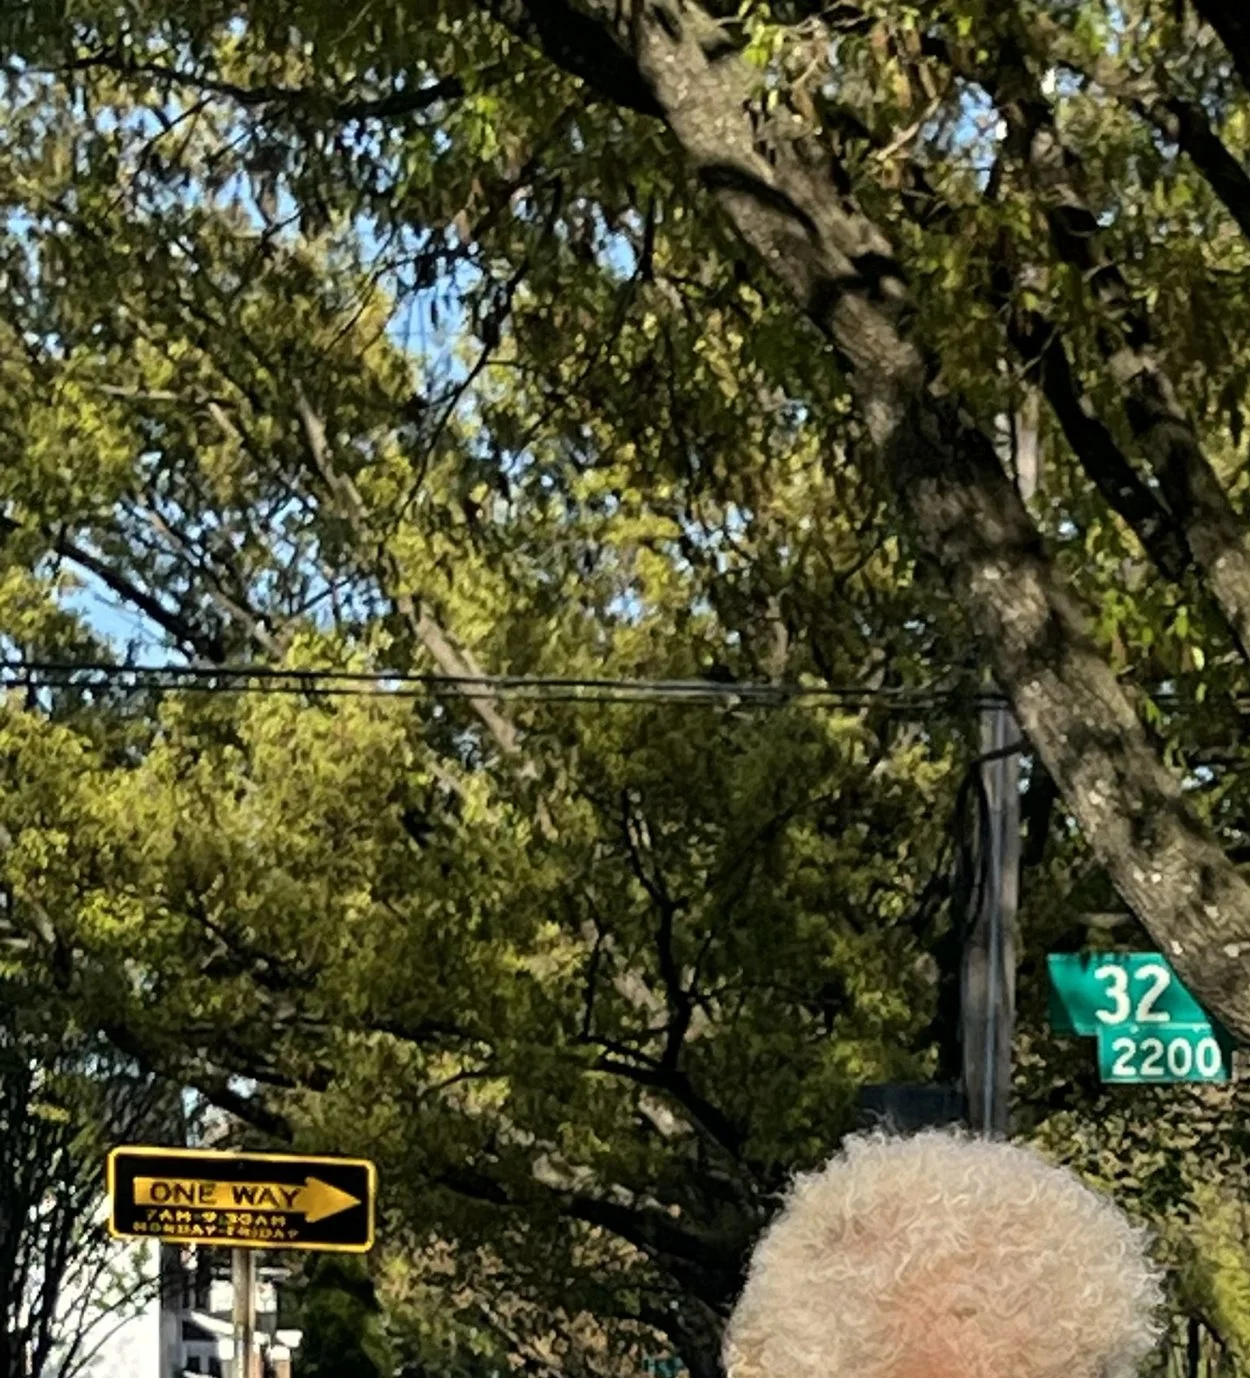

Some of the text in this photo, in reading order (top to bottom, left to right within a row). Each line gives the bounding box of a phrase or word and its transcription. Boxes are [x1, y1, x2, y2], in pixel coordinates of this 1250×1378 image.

[1094, 964, 1171, 1024] 32
[1112, 1037, 1222, 1077] 2200
[150, 1181, 301, 1208] ONE WAY
